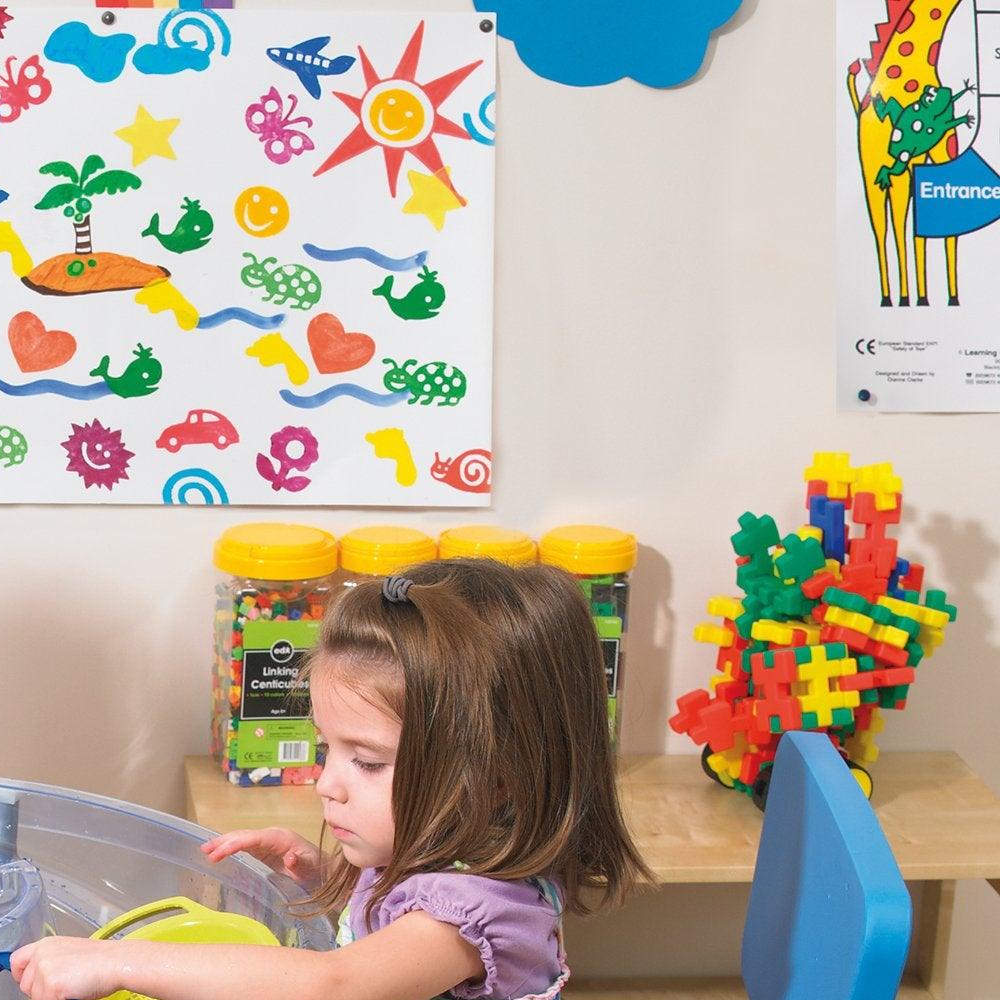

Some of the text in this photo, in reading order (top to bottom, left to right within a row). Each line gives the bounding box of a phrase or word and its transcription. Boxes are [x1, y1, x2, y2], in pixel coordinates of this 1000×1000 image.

[920, 181, 1000, 199] Entrance
[964, 349, 998, 358] Learning
[262, 667, 299, 678] Linking
